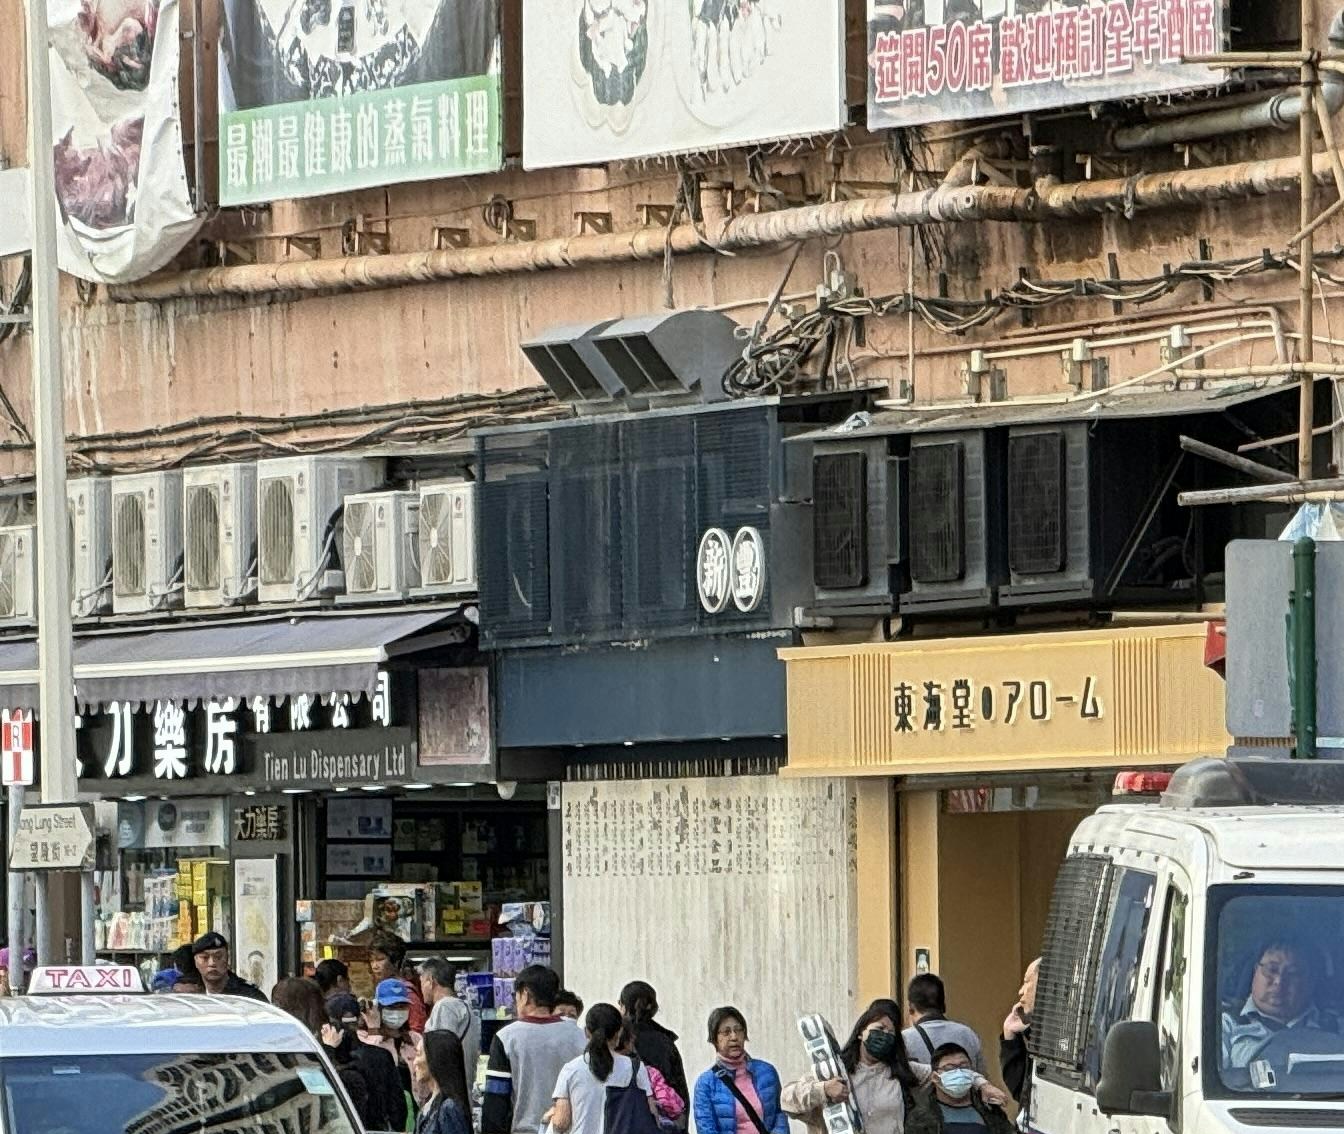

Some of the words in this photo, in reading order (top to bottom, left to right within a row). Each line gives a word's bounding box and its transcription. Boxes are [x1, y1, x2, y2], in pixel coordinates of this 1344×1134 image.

[876, 22, 992, 100] 筵開50席
[1001, 0, 1216, 86] 歡迎預訂全年酒席
[226, 90, 489, 187] 最潮最健康的蒸氣料理
[74, 671, 390, 780] 力藥房有限公司
[894, 679, 973, 733] 東海堂
[12, 725, 20, 747] R
[264, 751, 289, 781] Tien
[293, 750, 307, 779] Lu
[311, 749, 380, 782] Dispensary
[385, 744, 406, 776] Ltd
[20, 818, 34, 834] ong
[53, 813, 76, 829] Street
[46, 969, 132, 988] TAXI
